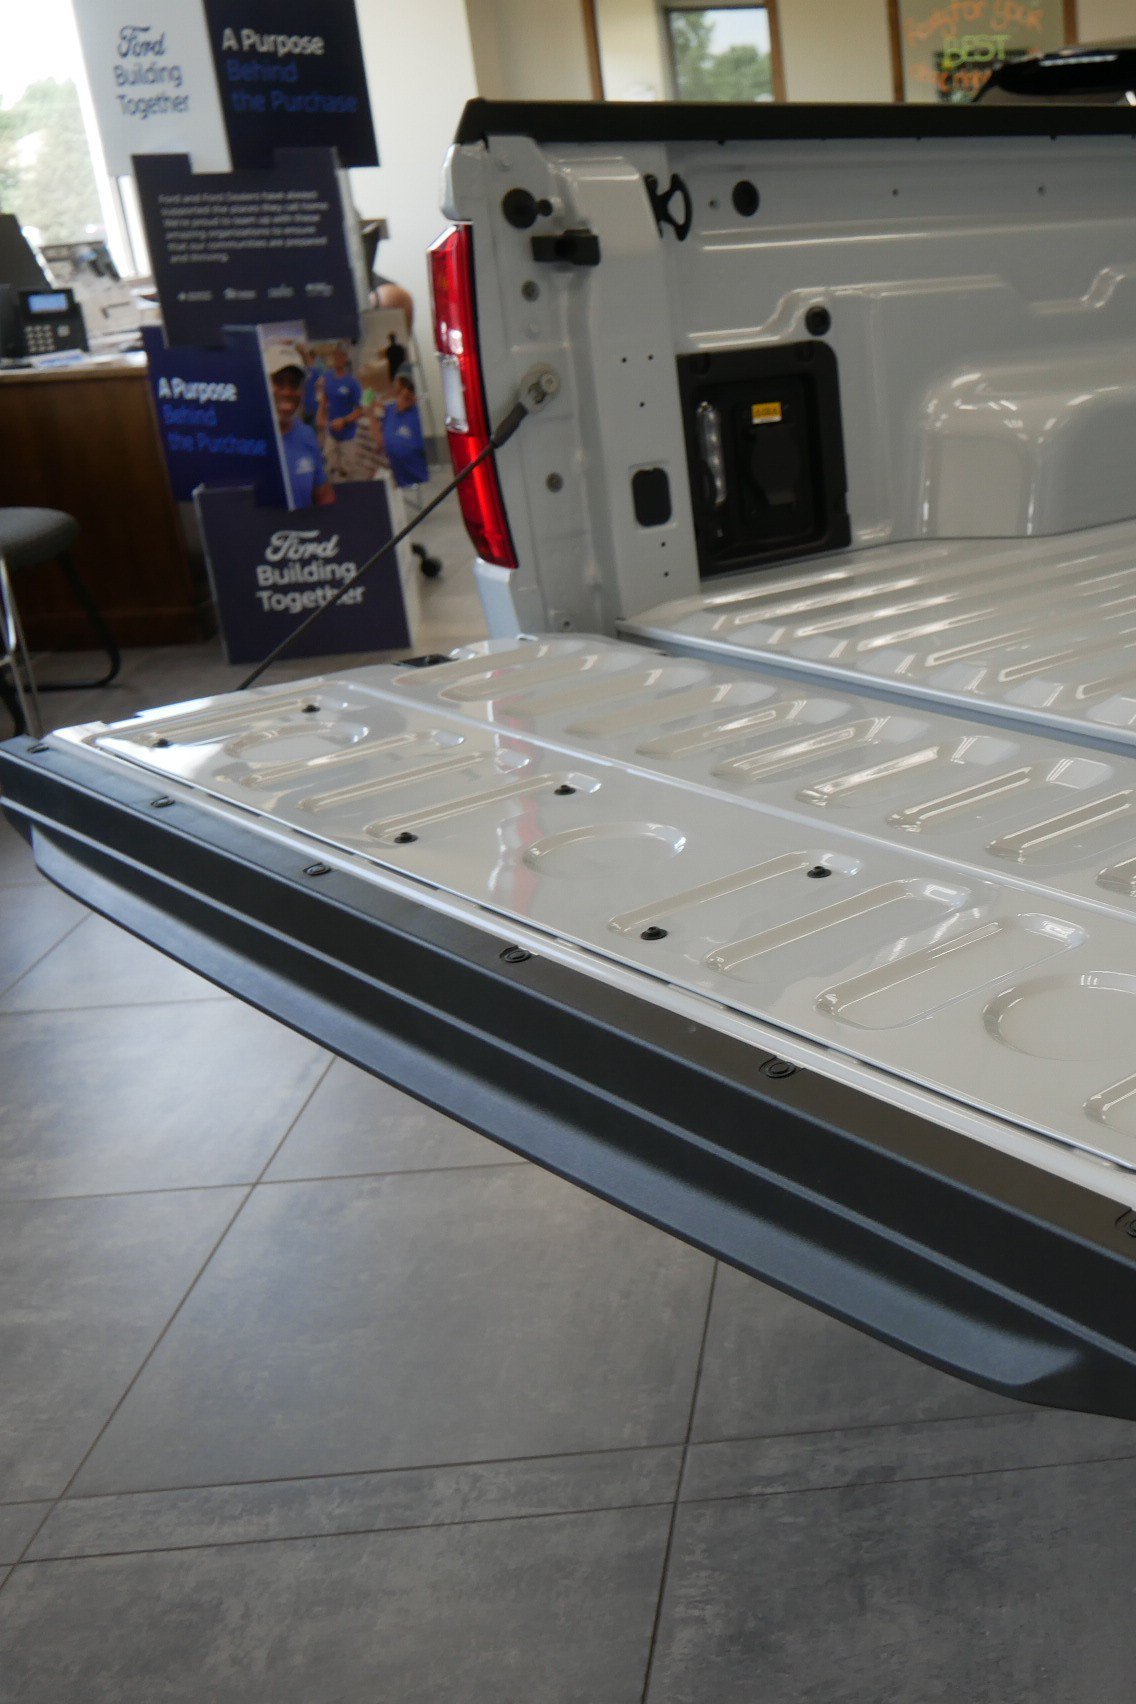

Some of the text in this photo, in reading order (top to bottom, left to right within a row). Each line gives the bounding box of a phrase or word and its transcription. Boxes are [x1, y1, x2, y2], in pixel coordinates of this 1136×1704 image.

[117, 25, 166, 58] Ford
[222, 27, 325, 57] A Purpose
[943, 34, 1011, 68] BEST
[113, 62, 182, 87] Building
[116, 92, 189, 119] Together
[158, 377, 238, 404] A Purpose
[264, 530, 340, 562] Ford
[256, 560, 358, 587] Building
[256, 585, 365, 614] Together
